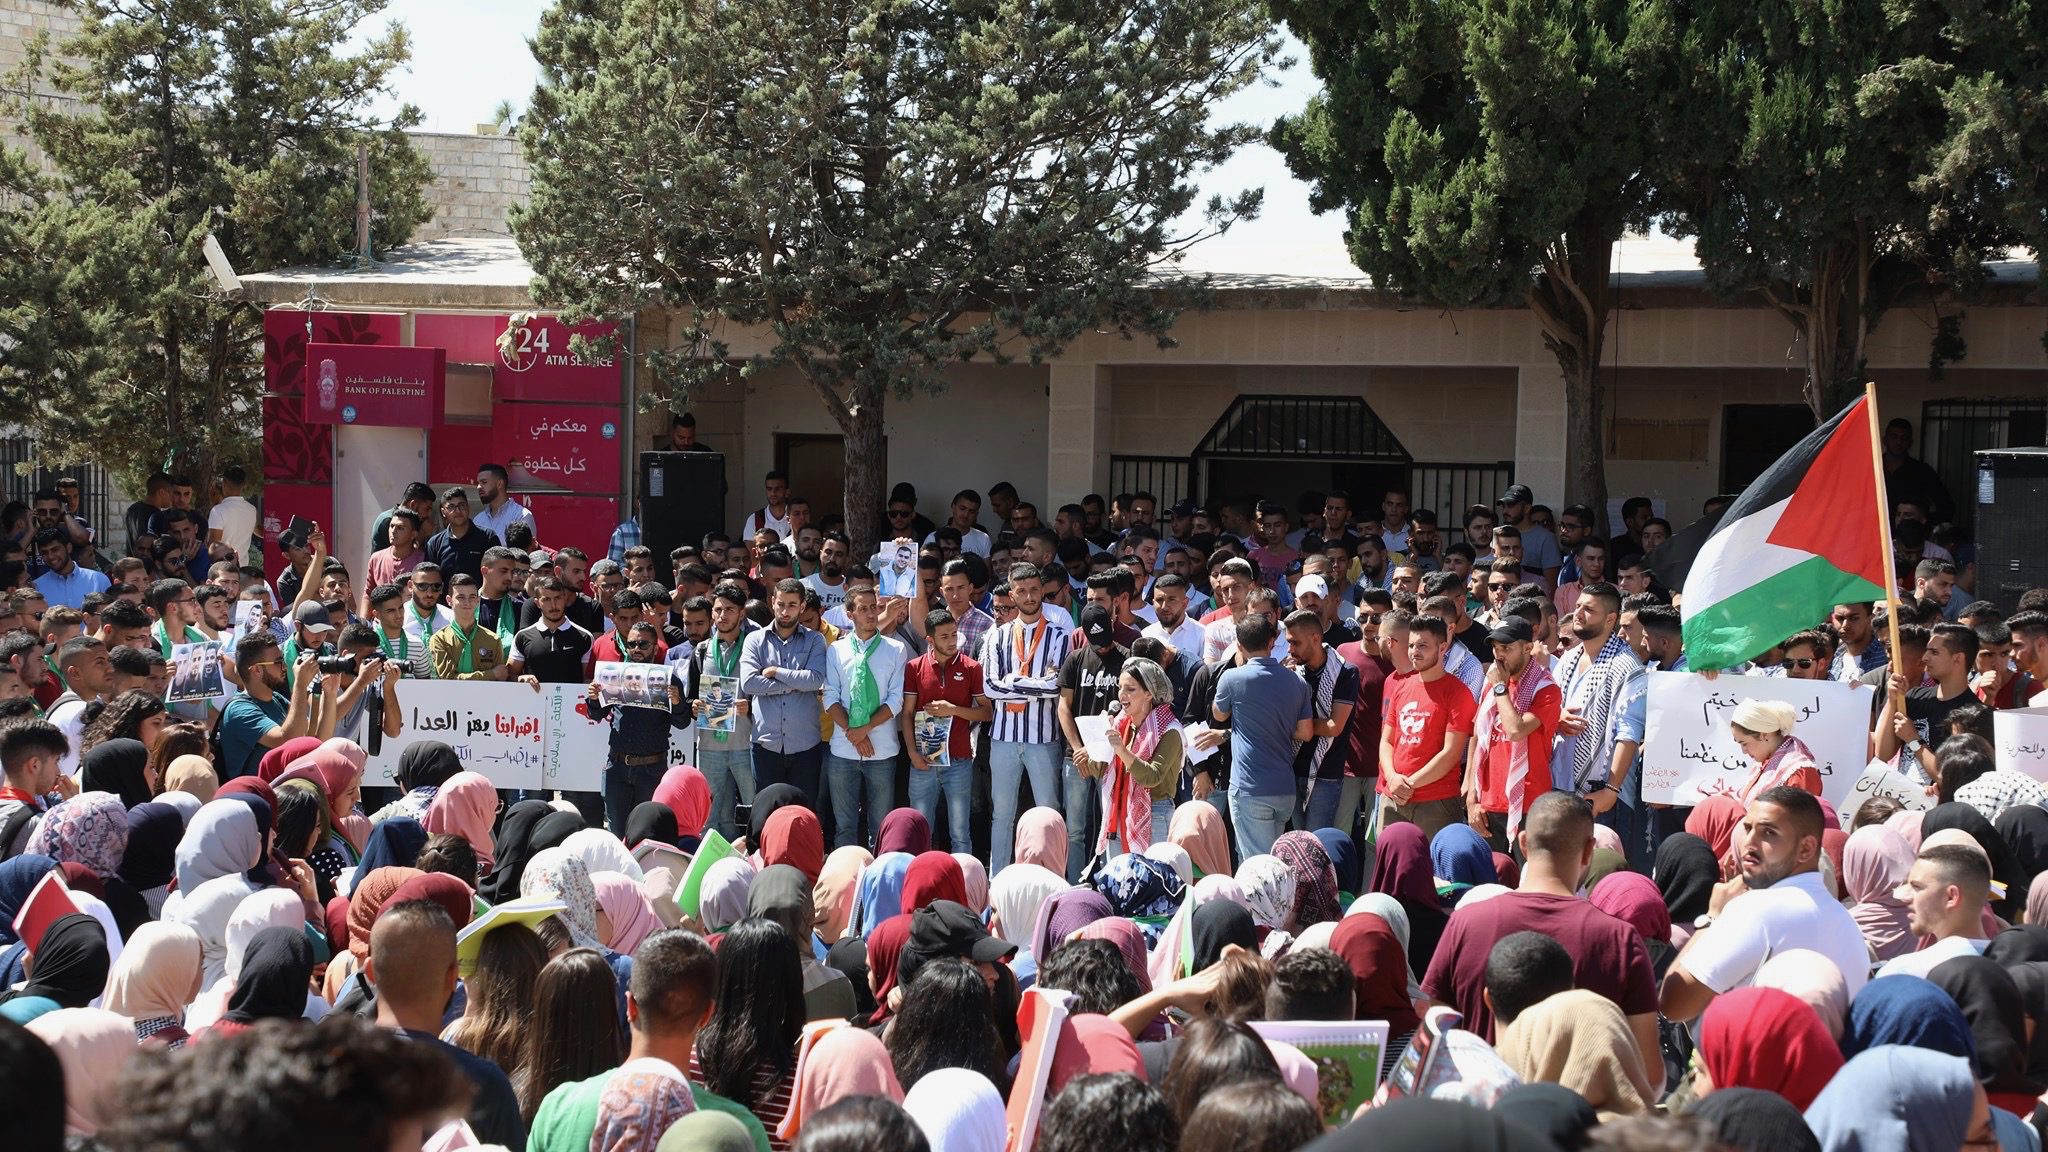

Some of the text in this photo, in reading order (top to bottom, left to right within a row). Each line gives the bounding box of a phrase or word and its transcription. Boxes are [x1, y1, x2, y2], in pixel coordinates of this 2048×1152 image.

[517, 327, 550, 353] 24
[545, 355, 568, 366] ATM
[345, 386, 367, 394] BANK
[381, 387, 425, 396] PALESTINE
[530, 417, 587, 440] معكم في
[523, 455, 586, 475] كل خطوة
[467, 711, 492, 737] يهز
[1722, 755, 1748, 771] من
